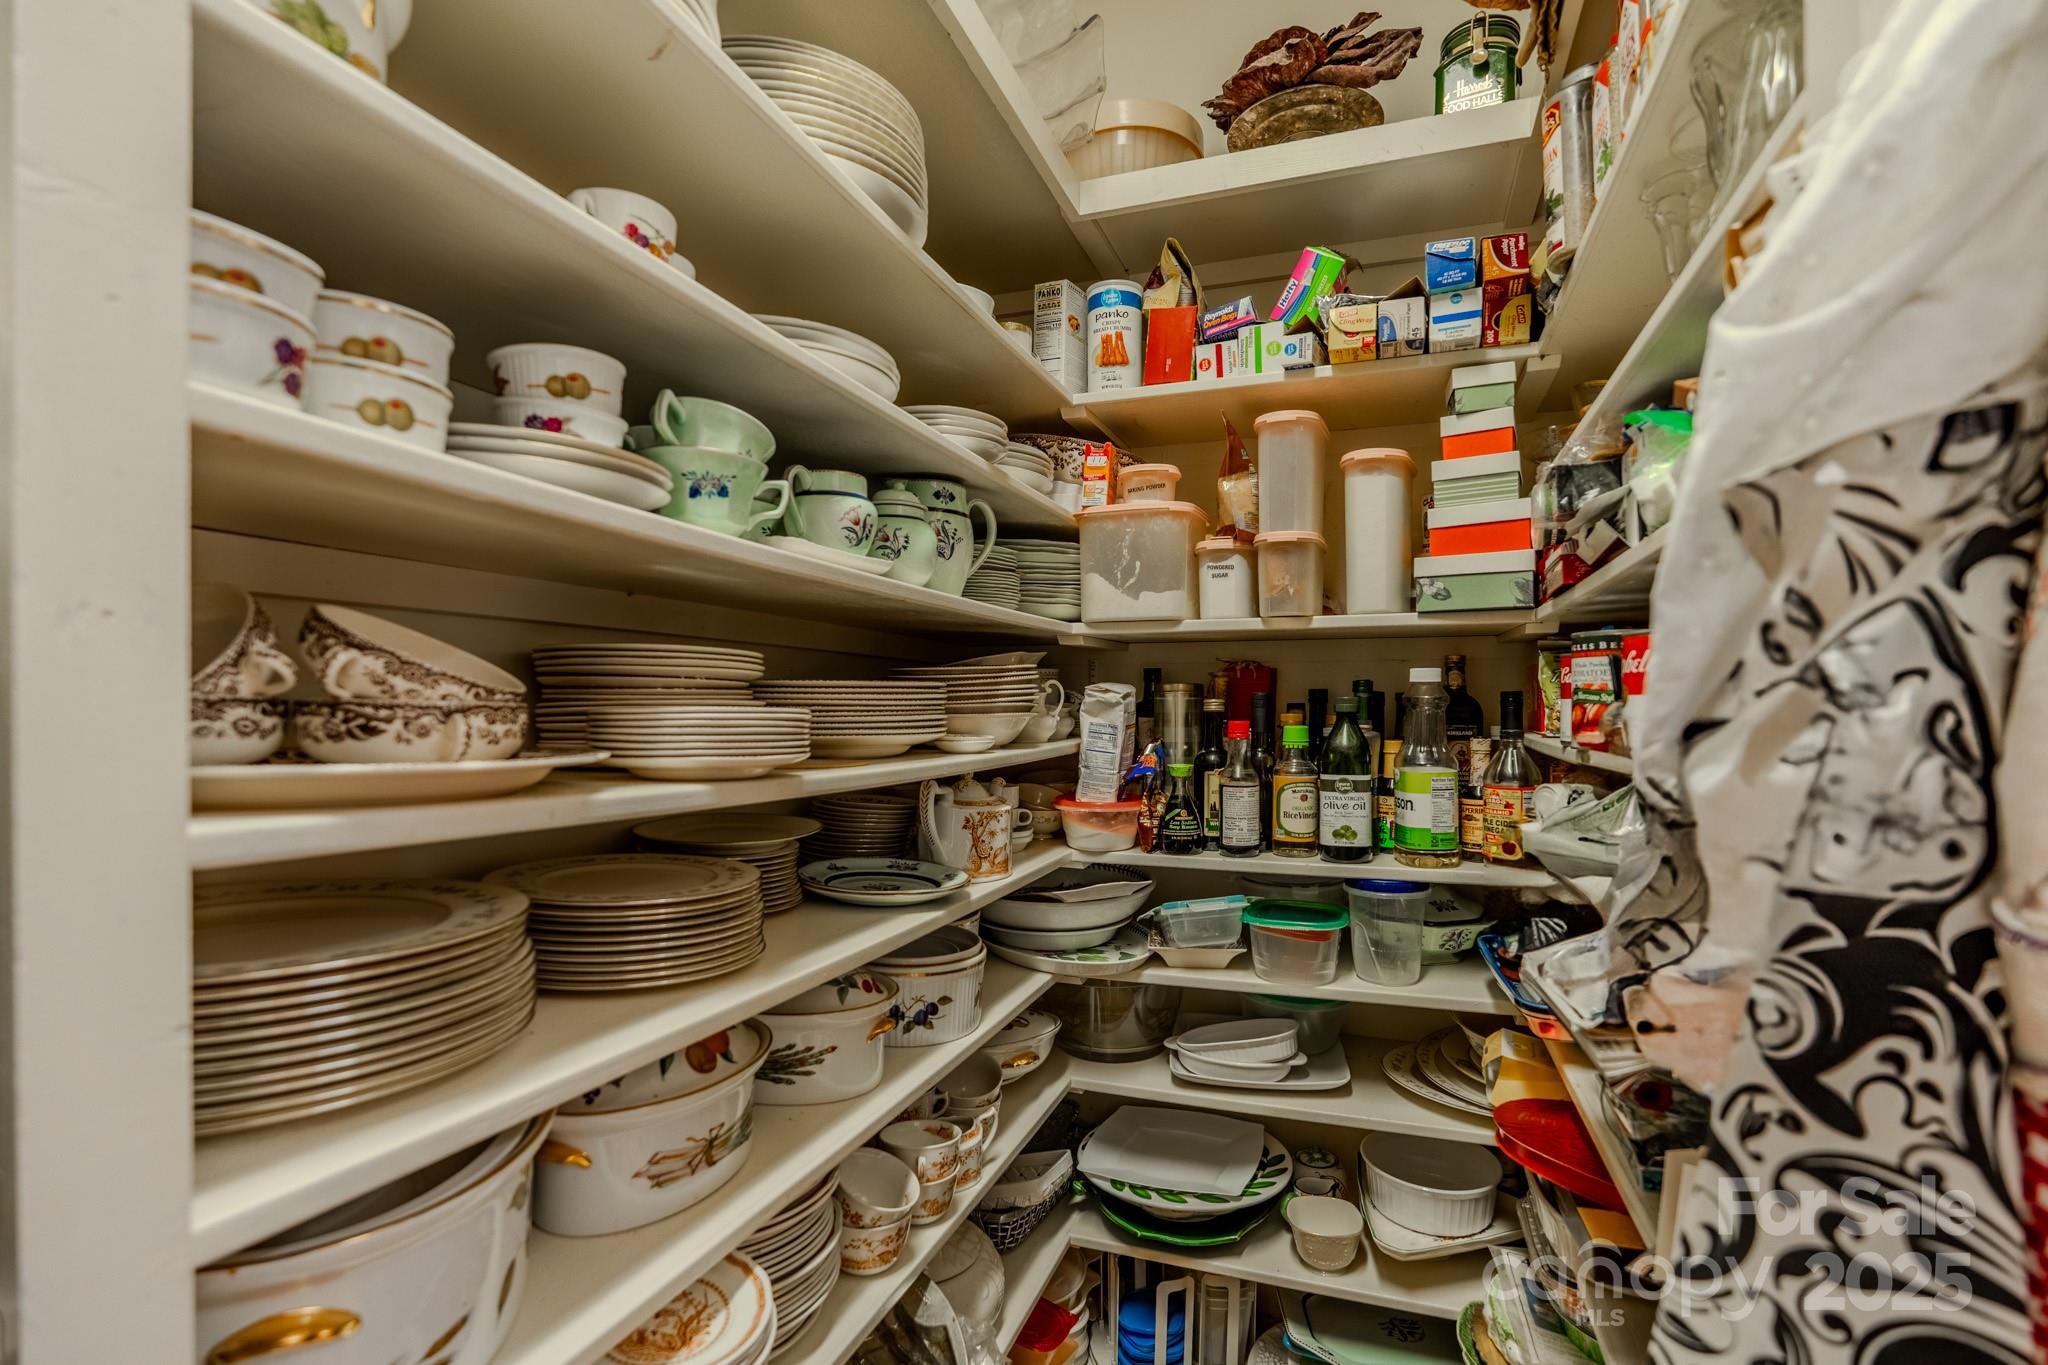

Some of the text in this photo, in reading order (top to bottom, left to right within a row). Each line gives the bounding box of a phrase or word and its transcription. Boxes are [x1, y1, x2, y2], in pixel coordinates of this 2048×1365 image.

[1453, 74, 1493, 98] Harrods
[1443, 91, 1505, 114] FOOD HALLS
[1501, 238, 1509, 256] Paper
[1508, 237, 1518, 267] Parchment
[1037, 287, 1061, 299] PANKO
[1095, 309, 1129, 323] panko
[1203, 318, 1221, 329] Oven
[1220, 312, 1238, 323] Bags
[1204, 305, 1234, 321] Reynolds
[1515, 304, 1526, 324] GLAD
[1411, 327, 1420, 338] 45
[1487, 329, 1495, 343] 200
[1127, 483, 1167, 494] BAKING POWDER
[1322, 801, 1366, 811] olive oil
[1283, 811, 1299, 819] Rice
